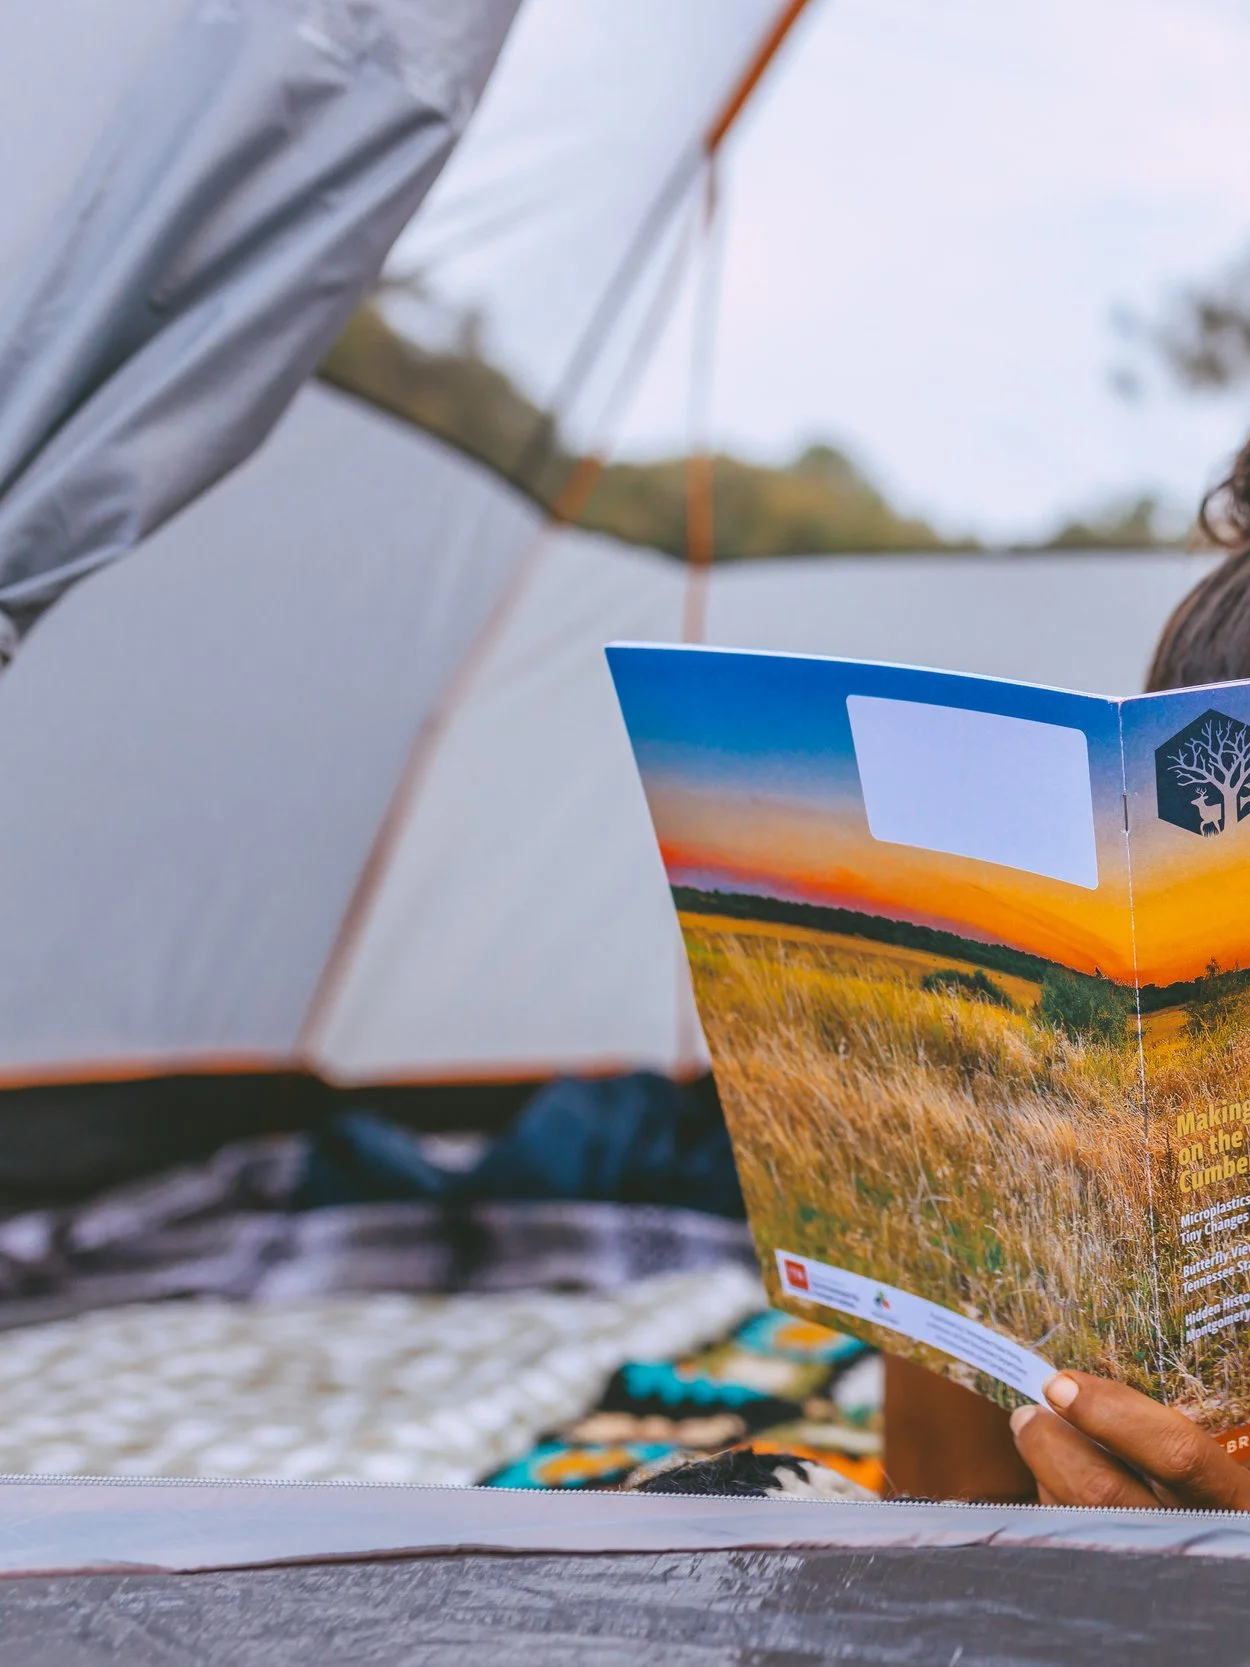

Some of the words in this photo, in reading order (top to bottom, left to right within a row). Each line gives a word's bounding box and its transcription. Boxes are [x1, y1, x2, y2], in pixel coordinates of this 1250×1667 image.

[1178, 1142, 1203, 1166] on
[1208, 1128, 1243, 1155] the
[1180, 1229, 1202, 1245] Tiny
[1204, 1212, 1249, 1237] Changes
[1181, 1196, 1250, 1229] Microplastics
[1183, 1249, 1229, 1278] Butterfly
[1182, 1266, 1235, 1295] Tennessee
[1185, 1305, 1221, 1327] Hidden
[1185, 1308, 1250, 1343] Montgomery
